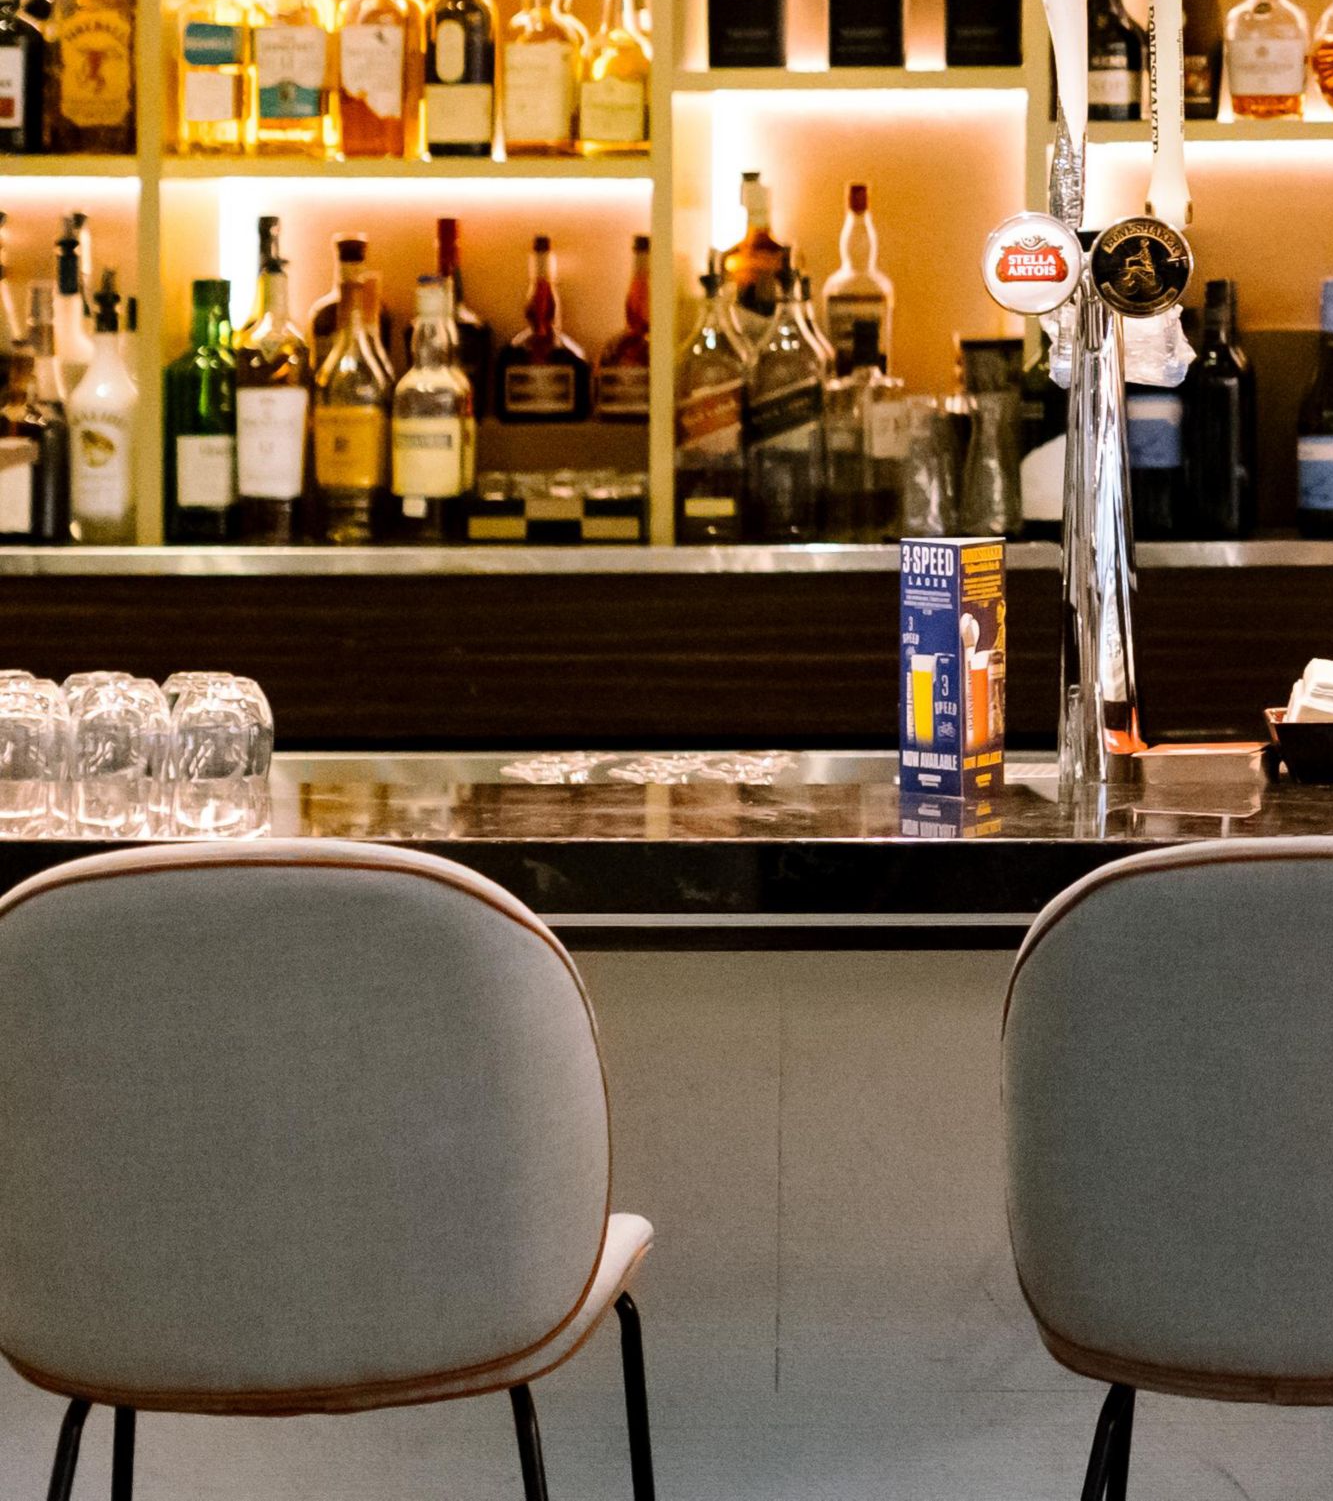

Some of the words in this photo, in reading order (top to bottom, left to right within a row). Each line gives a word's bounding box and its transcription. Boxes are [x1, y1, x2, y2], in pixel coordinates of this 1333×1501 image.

[1007, 255, 1056, 265] STELLA
[1007, 265, 1057, 276] ARTOIS
[908, 576, 948, 588] LAGER
[941, 675, 949, 696] 3
[934, 701, 957, 716] SPEED
[920, 752, 958, 771] AVAILABLE
